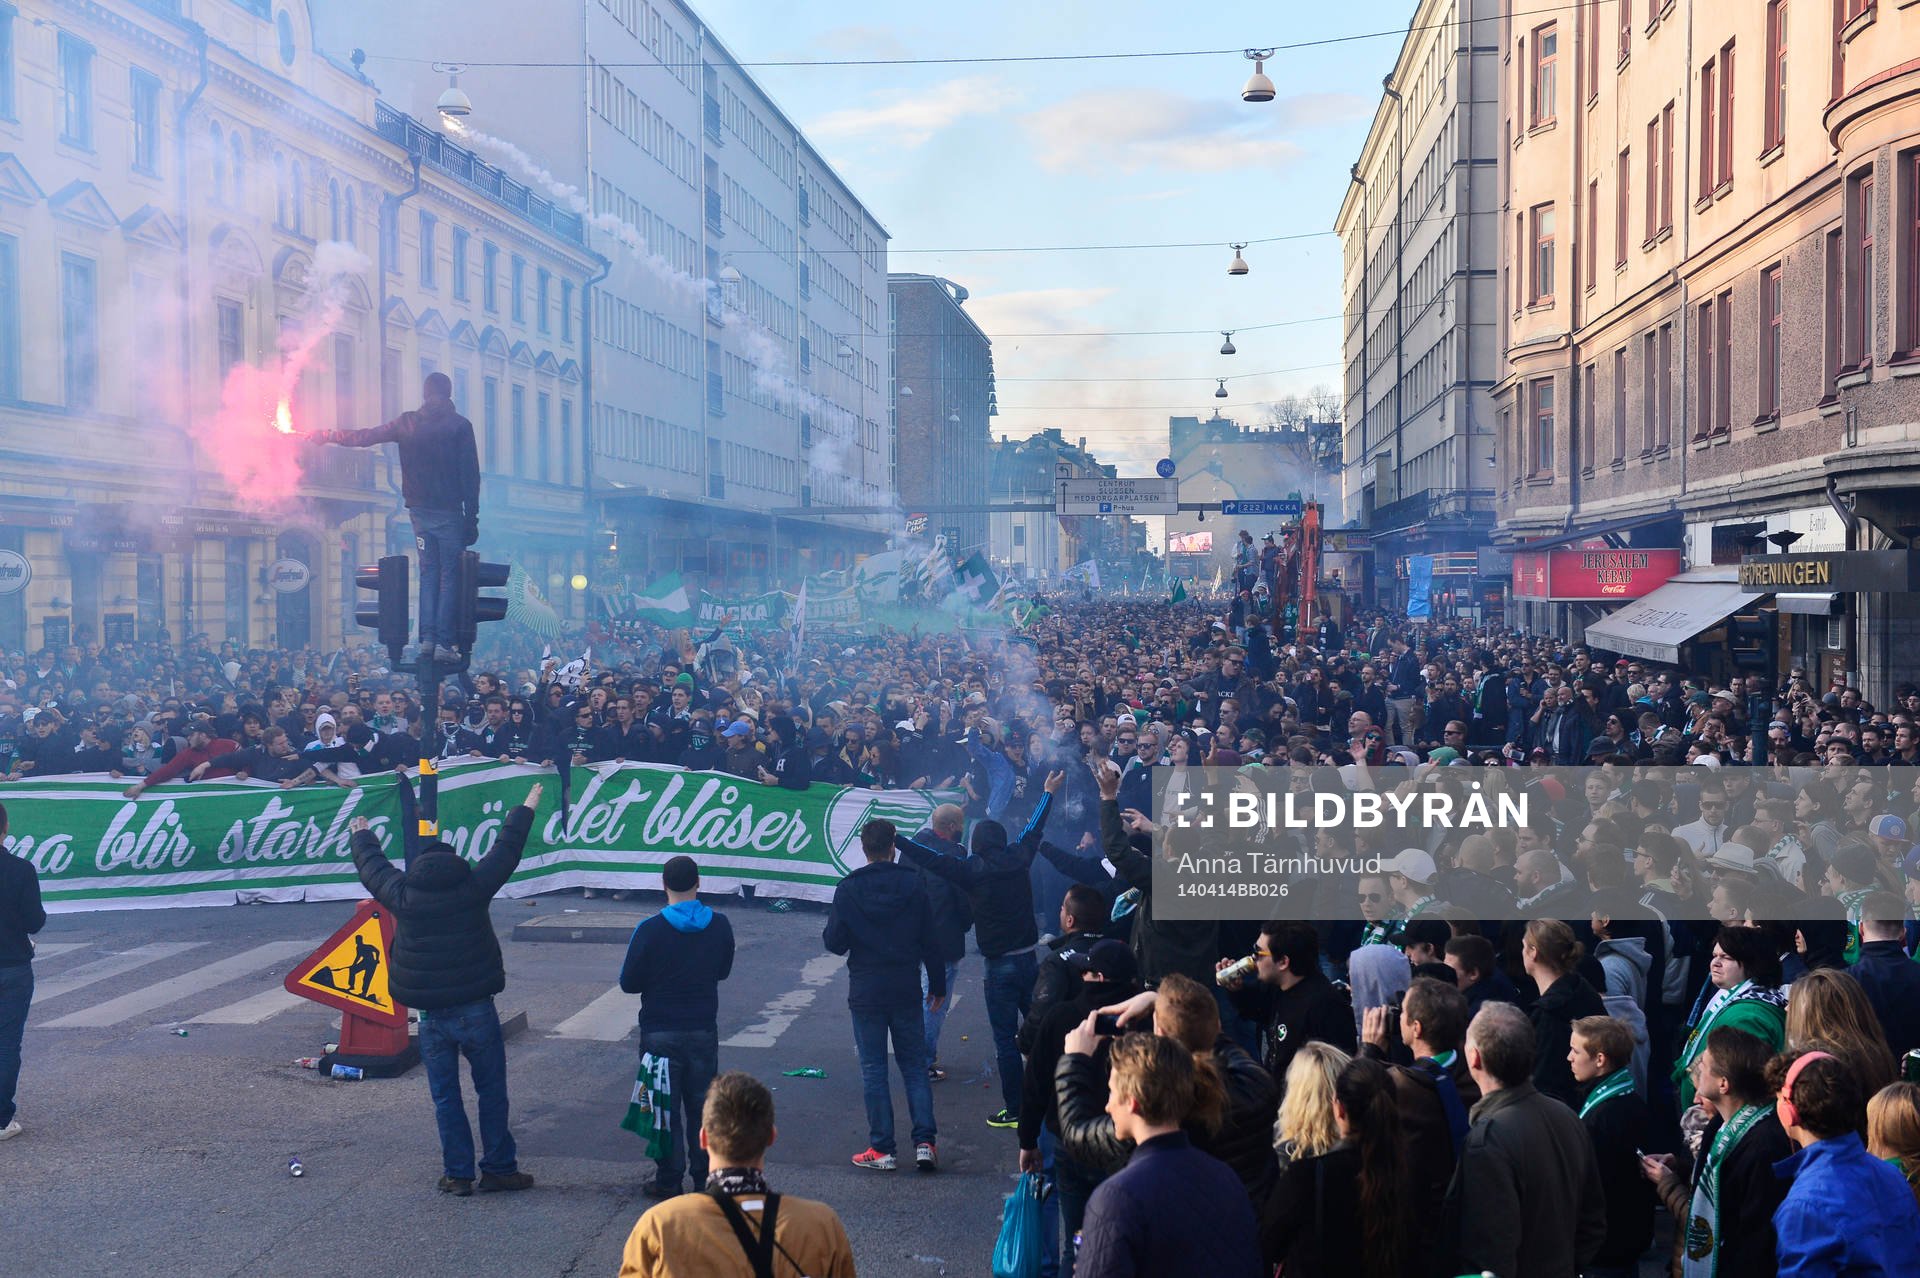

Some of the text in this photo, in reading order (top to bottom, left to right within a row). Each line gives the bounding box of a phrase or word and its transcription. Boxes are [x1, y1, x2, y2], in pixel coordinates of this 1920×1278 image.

[1098, 480, 1136, 488] CENTRUM
[1074, 494, 1160, 502] MEDBORGARPLATSEN
[1113, 504, 1135, 512] P-hus
[1240, 504, 1297, 513] 222 NACKA
[1582, 552, 1648, 569] JERUSALEM
[1597, 569, 1632, 584] KEBAB
[700, 602, 768, 621] NACKA
[95, 799, 196, 872] blir
[543, 777, 652, 845] det
[643, 773, 812, 854] blåser
